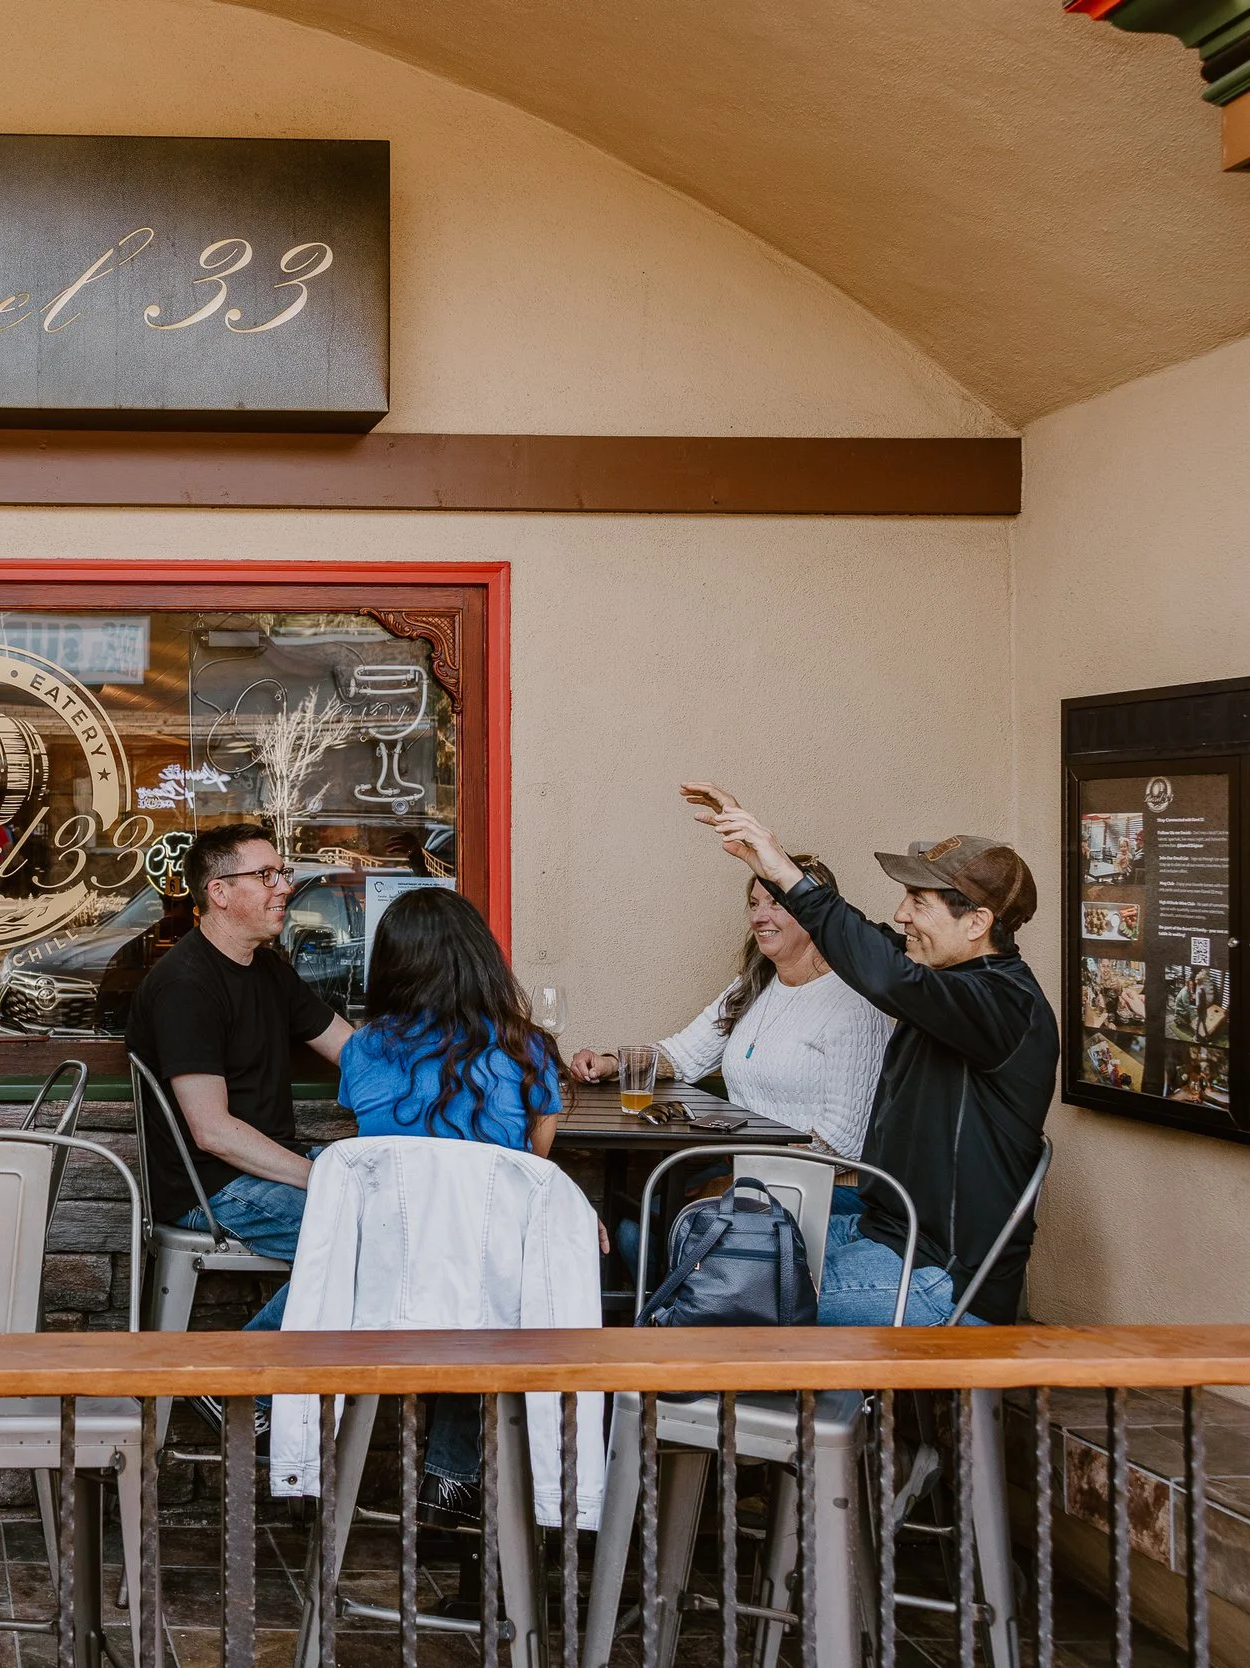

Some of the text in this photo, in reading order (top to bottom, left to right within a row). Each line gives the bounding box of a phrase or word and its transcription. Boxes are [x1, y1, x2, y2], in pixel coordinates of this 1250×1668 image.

[144, 237, 334, 333] 33
[30, 673, 108, 758] EATERY
[31, 814, 155, 889] 33
[12, 928, 80, 968] CHILL
